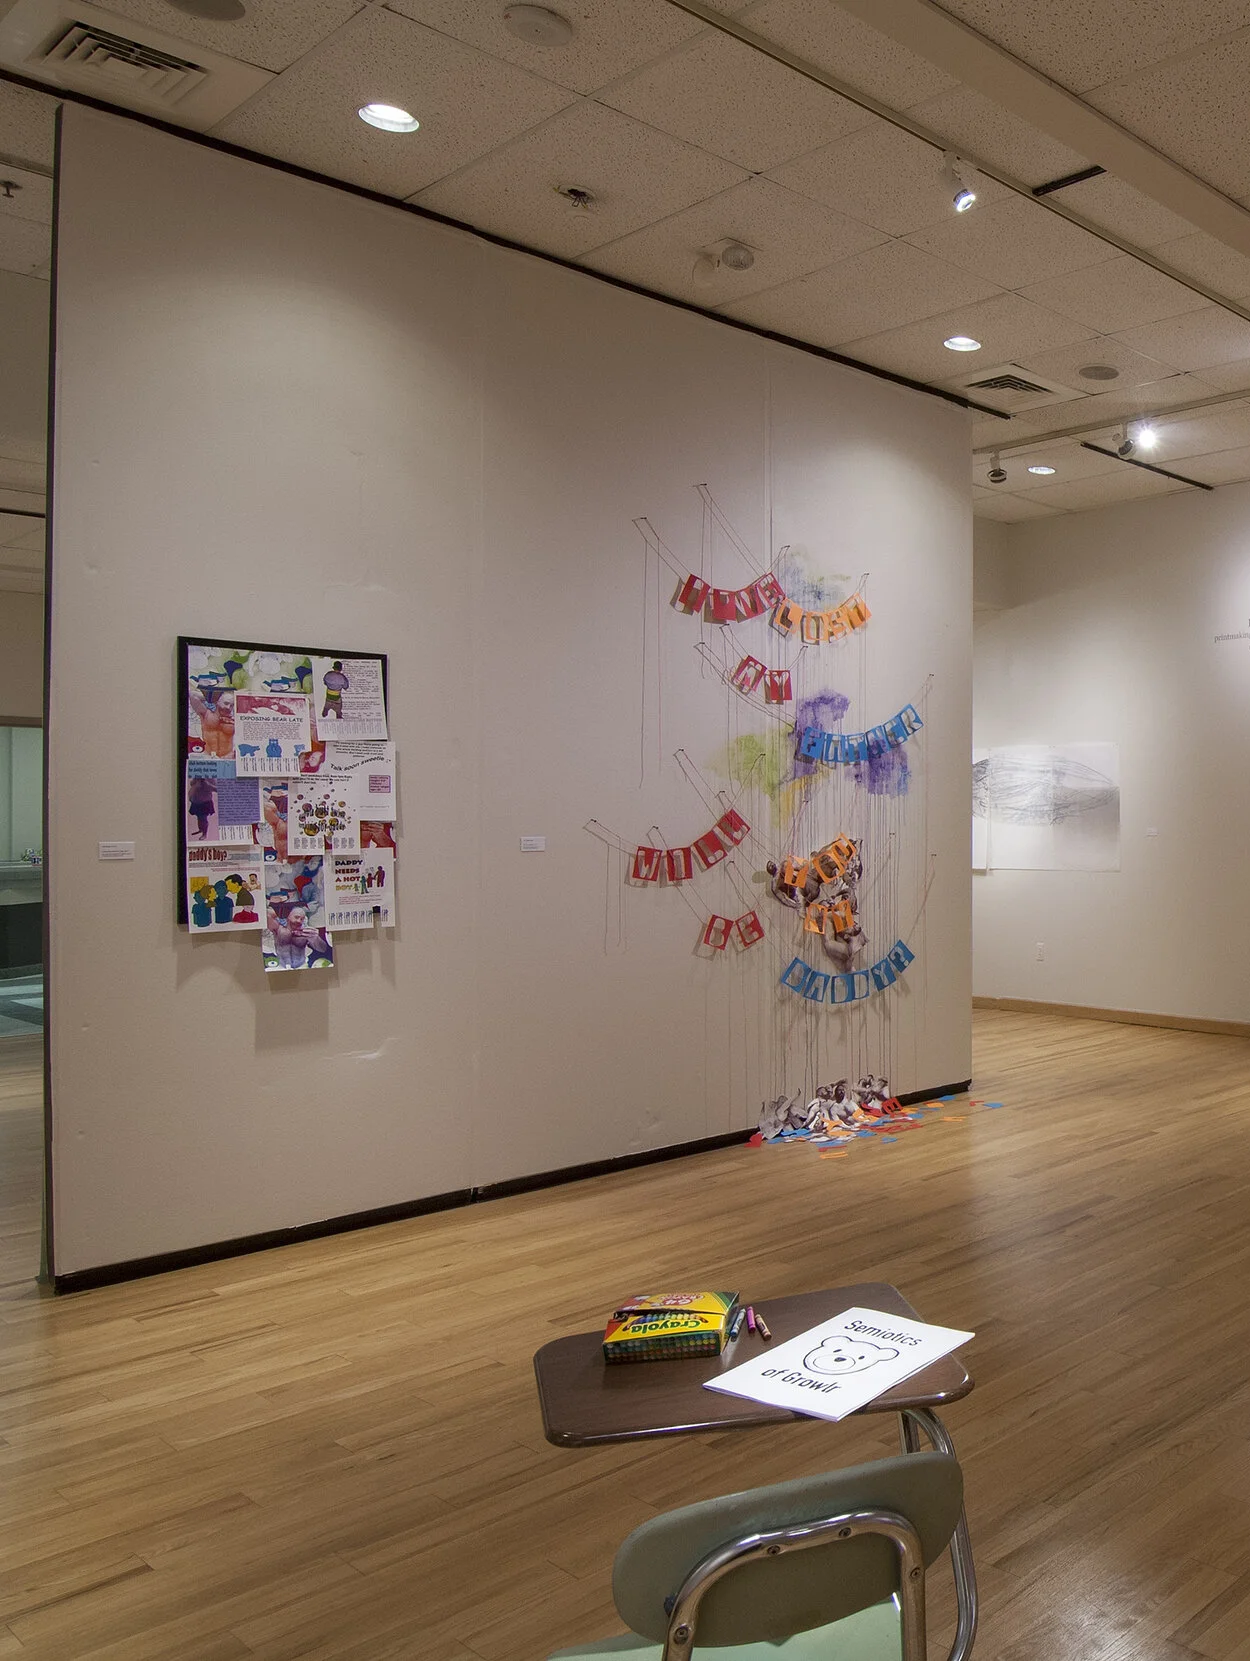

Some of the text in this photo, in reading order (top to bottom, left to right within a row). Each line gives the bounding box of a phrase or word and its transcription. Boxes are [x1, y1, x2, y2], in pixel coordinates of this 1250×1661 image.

[733, 655, 792, 701] MY
[801, 703, 924, 763] FATHER
[330, 755, 385, 772] Talk soon sweetie
[632, 809, 751, 881] WILL
[784, 832, 857, 888] YOU
[704, 910, 765, 950] BE
[781, 939, 915, 1004] DADDY?
[631, 1319, 701, 1334] Crayola
[844, 1319, 923, 1347] Semiotics
[761, 1367, 842, 1394] of Growlr
